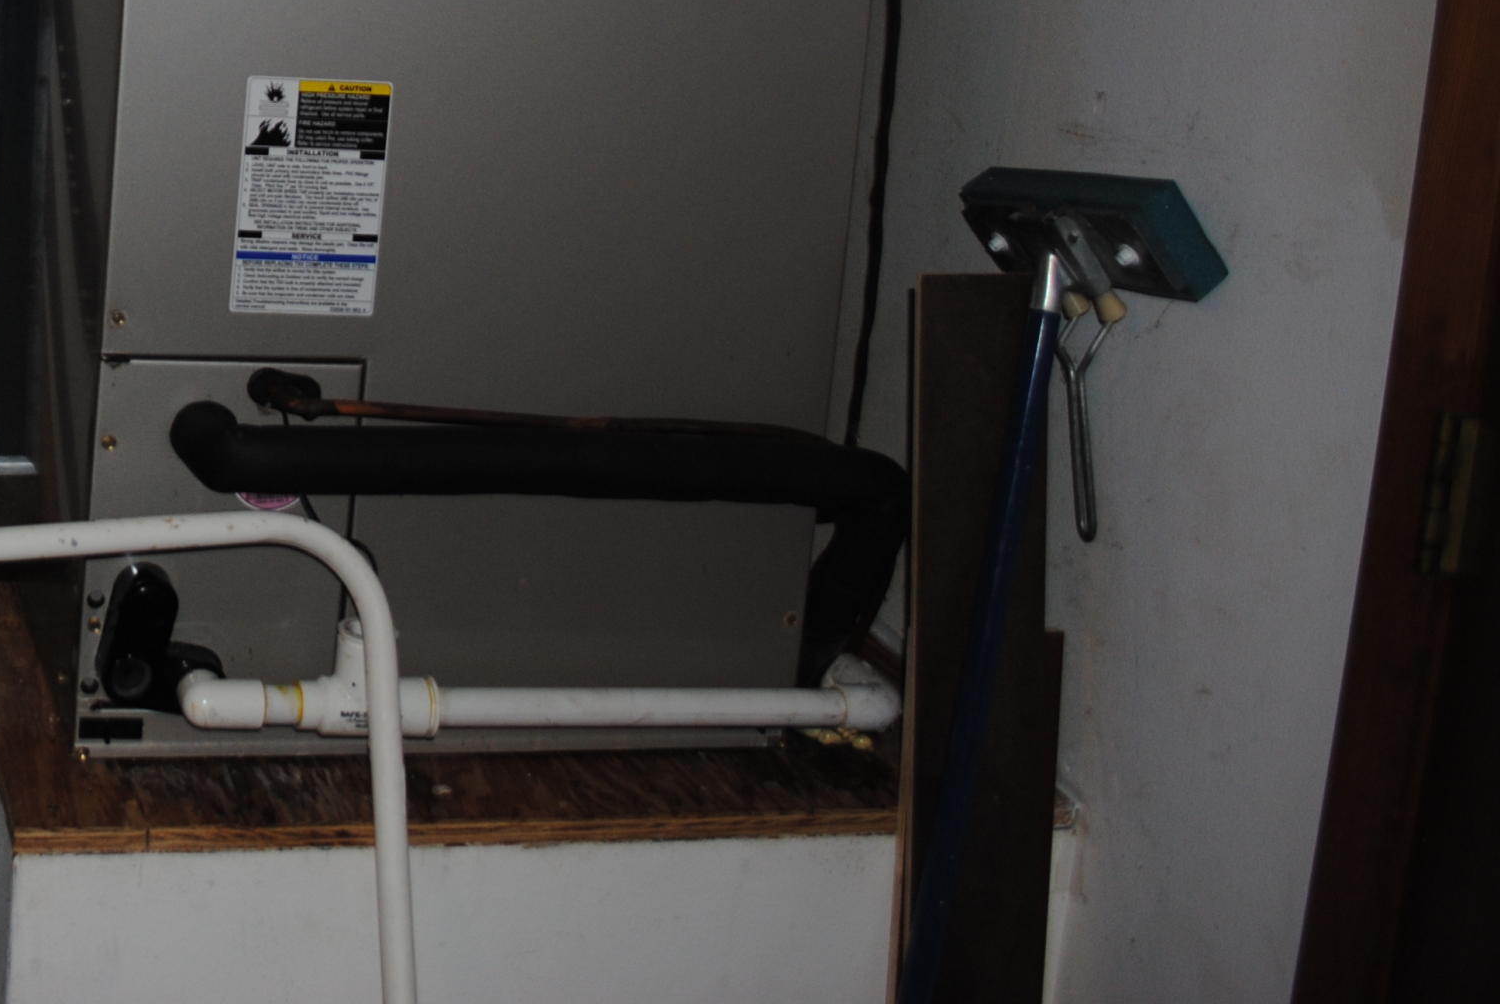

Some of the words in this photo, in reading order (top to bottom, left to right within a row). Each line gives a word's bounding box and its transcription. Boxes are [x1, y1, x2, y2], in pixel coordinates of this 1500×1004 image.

[339, 84, 373, 92] CAUTION
[286, 149, 339, 157] INSTALLATION
[291, 232, 322, 240] SERVICE
